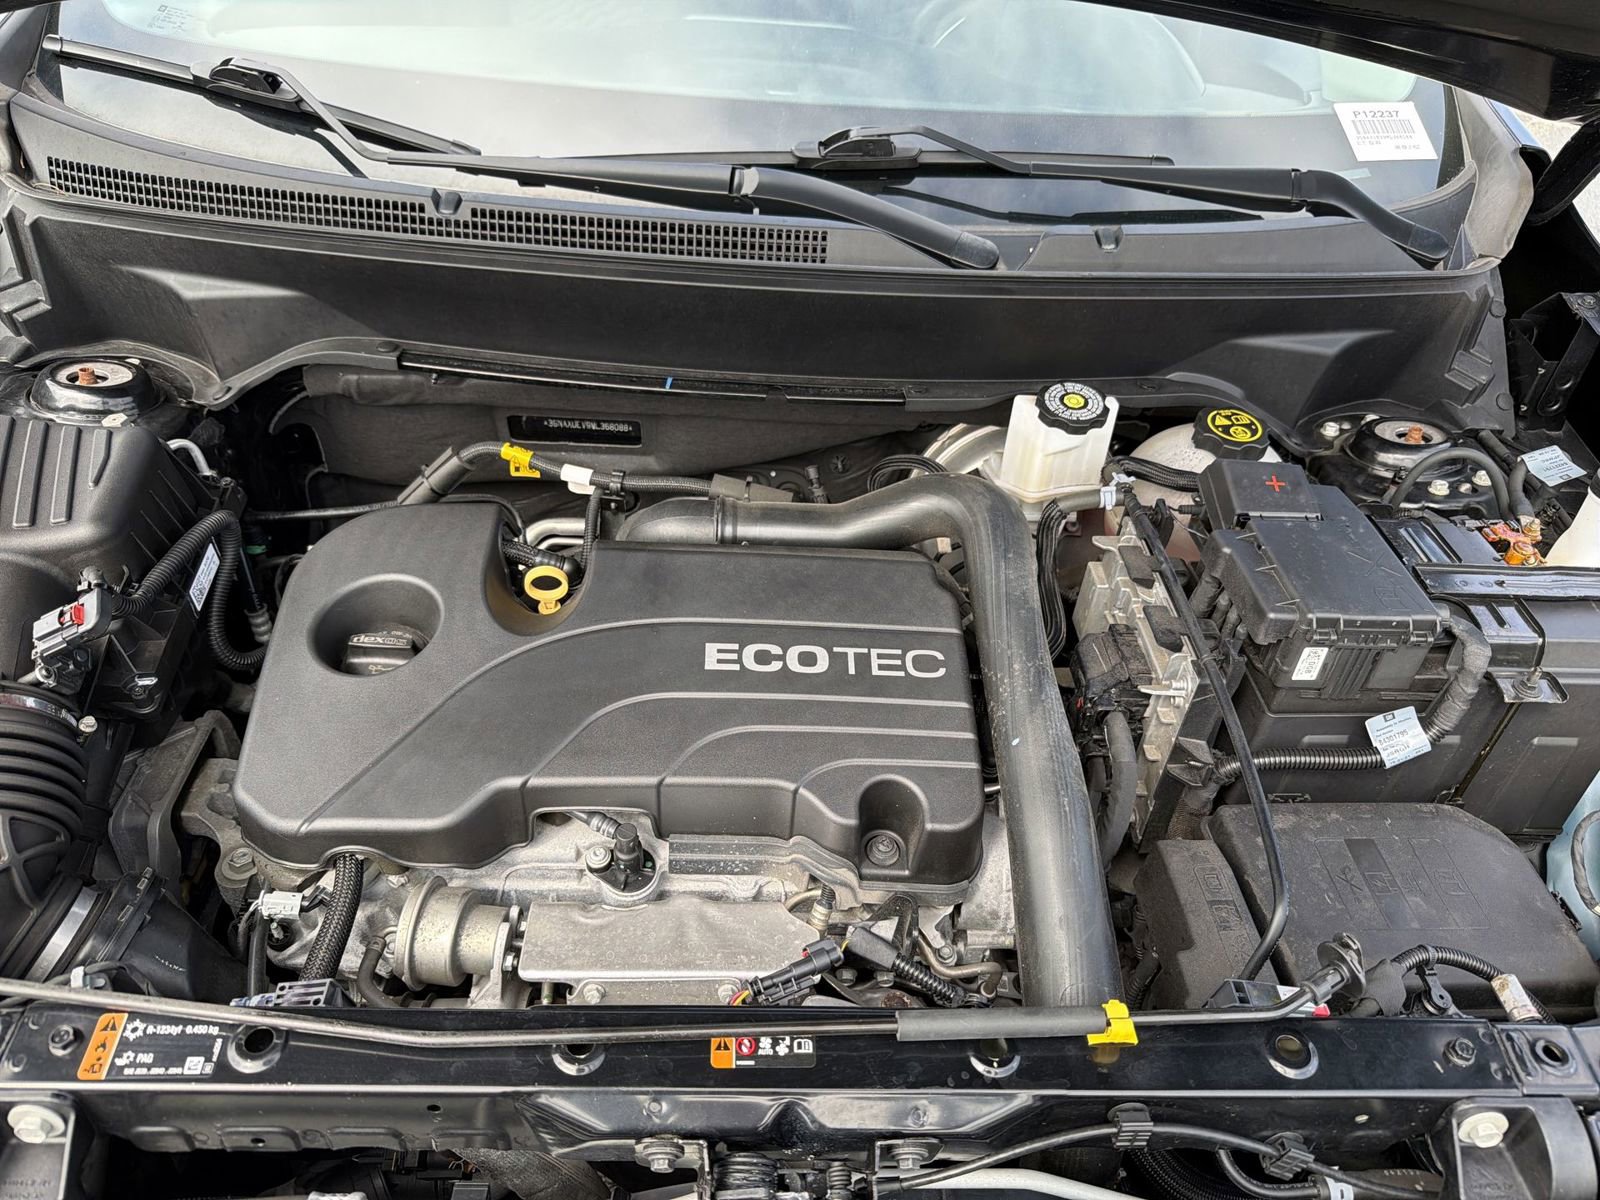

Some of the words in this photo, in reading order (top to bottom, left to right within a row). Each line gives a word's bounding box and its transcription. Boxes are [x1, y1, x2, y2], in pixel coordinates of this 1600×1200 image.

[1352, 110, 1400, 119] P12237
[704, 642, 947, 679] ECOTEC
[758, 1048, 774, 1056] AUTO
